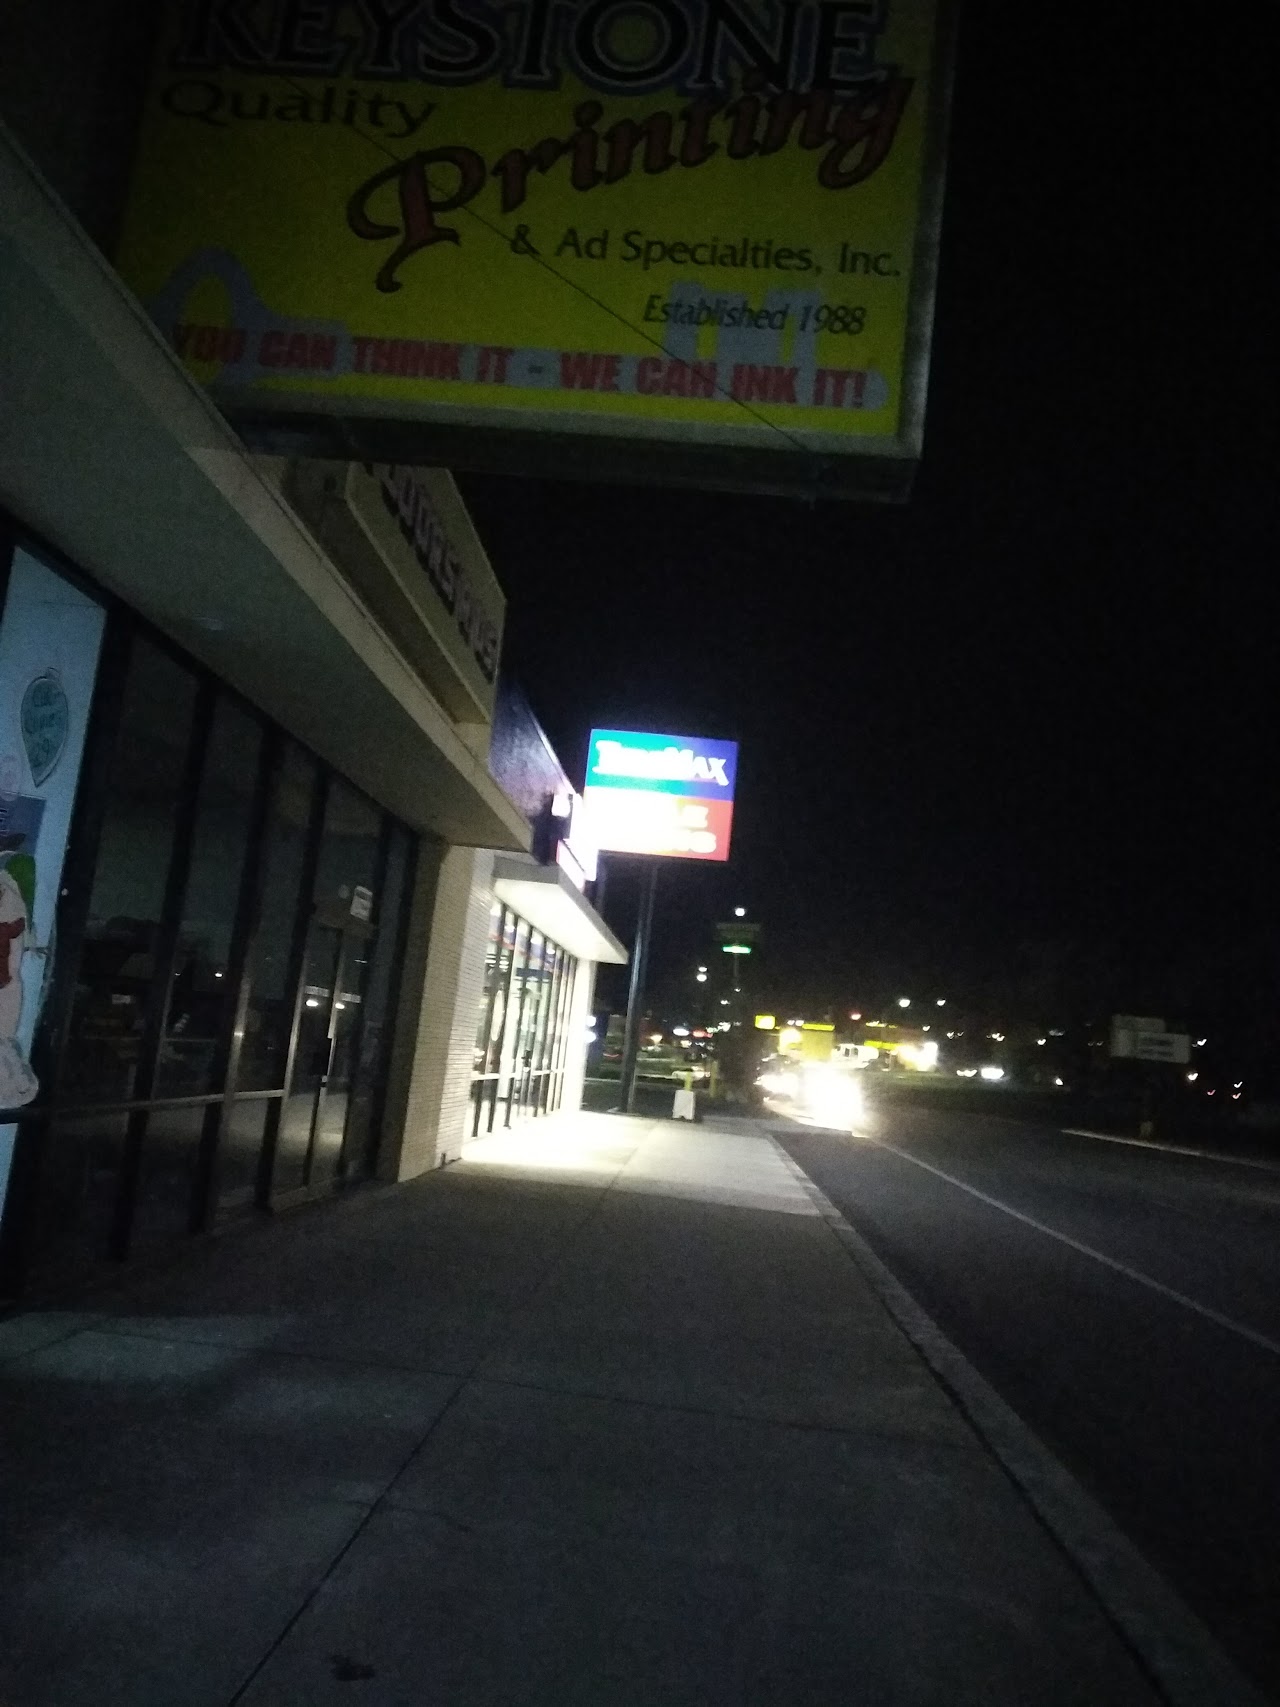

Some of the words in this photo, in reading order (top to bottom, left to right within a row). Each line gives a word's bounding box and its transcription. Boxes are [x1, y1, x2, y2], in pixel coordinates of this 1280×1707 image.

[161, 78, 438, 138] Quality
[347, 78, 913, 292] Printing
[509, 223, 541, 258] &
[554, 227, 609, 261] Ad
[620, 230, 822, 274] Specialties,
[837, 242, 901, 276] Inc.
[643, 294, 790, 331] Established
[797, 304, 867, 336] 1988
[173, 323, 246, 364] YOU
[257, 328, 337, 371] CAN
[352, 335, 461, 381] THINK
[477, 346, 515, 384] IT
[560, 352, 620, 391] WE
[636, 356, 719, 399] CAN
[730, 363, 800, 404] INK
[813, 368, 868, 409] IT!
